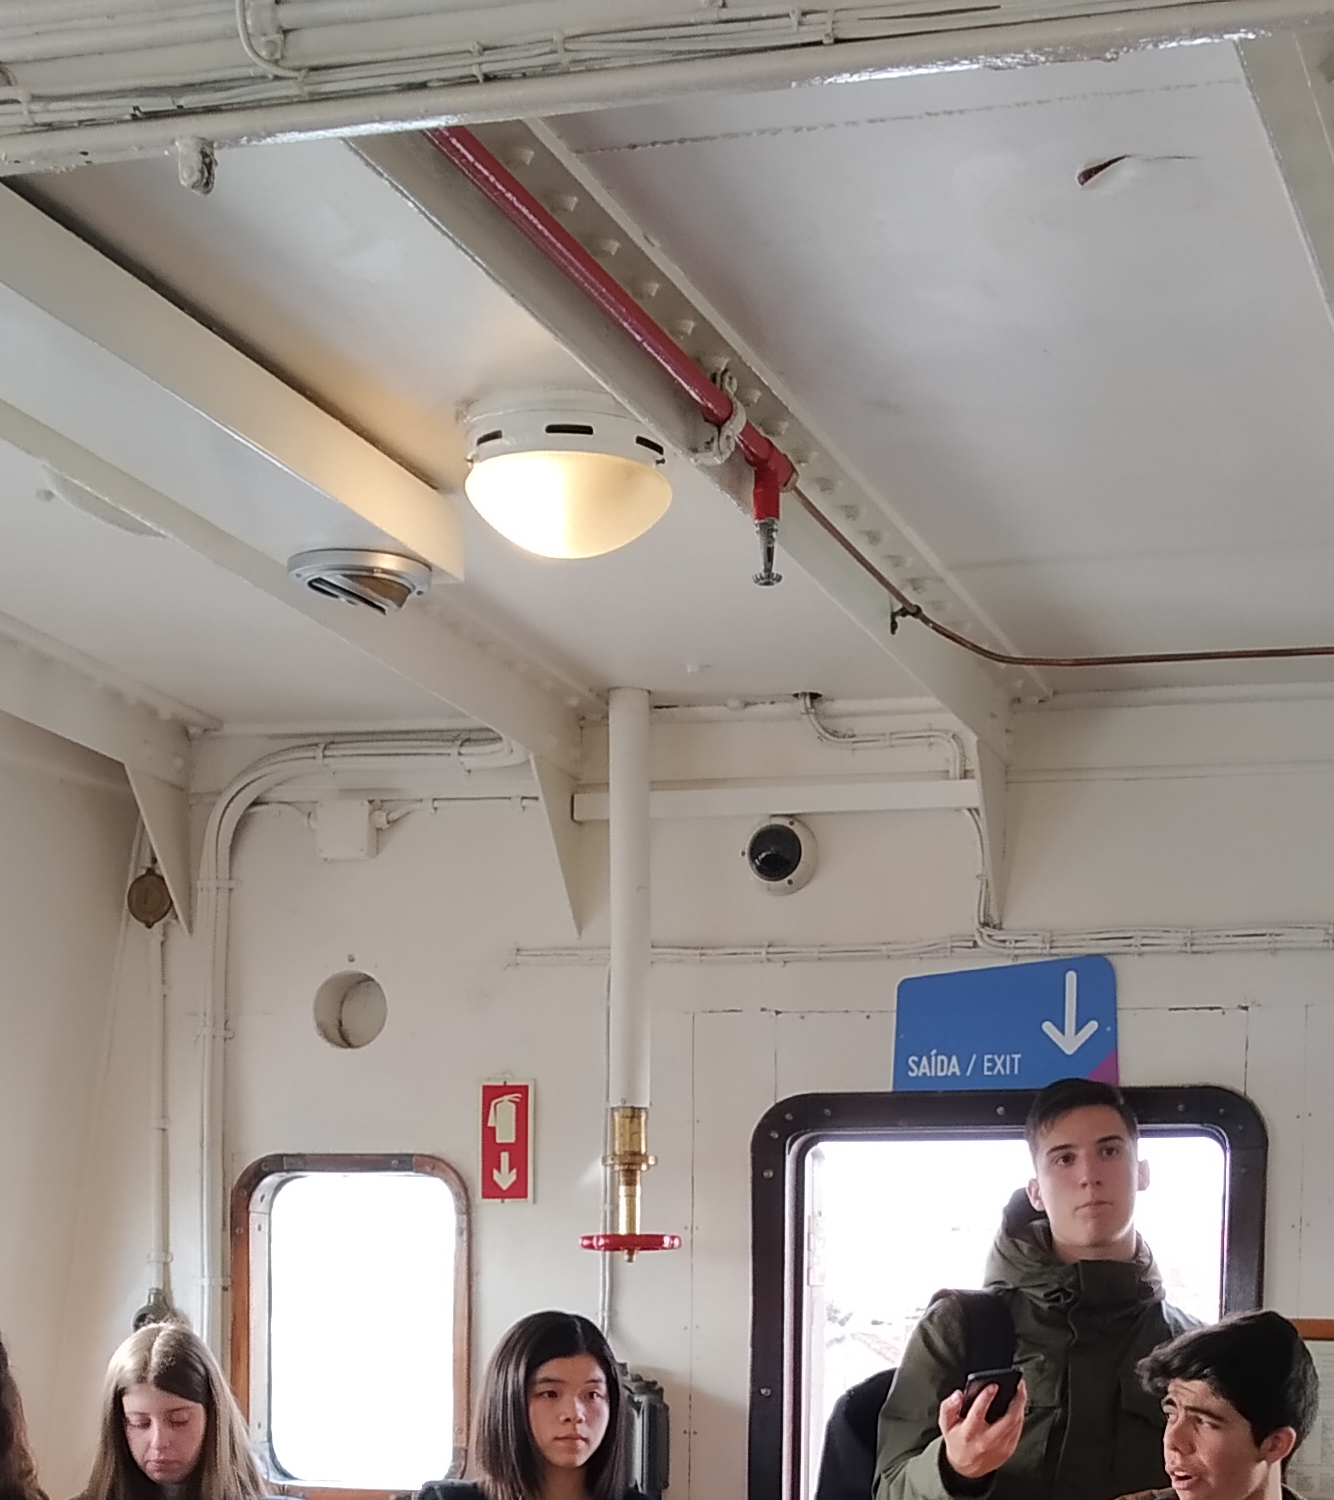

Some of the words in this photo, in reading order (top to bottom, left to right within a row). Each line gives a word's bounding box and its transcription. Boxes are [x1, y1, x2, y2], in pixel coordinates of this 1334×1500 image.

[907, 1049, 961, 1077] SAÍDA
[966, 1054, 977, 1076] /
[983, 1054, 1022, 1076] EXIT
